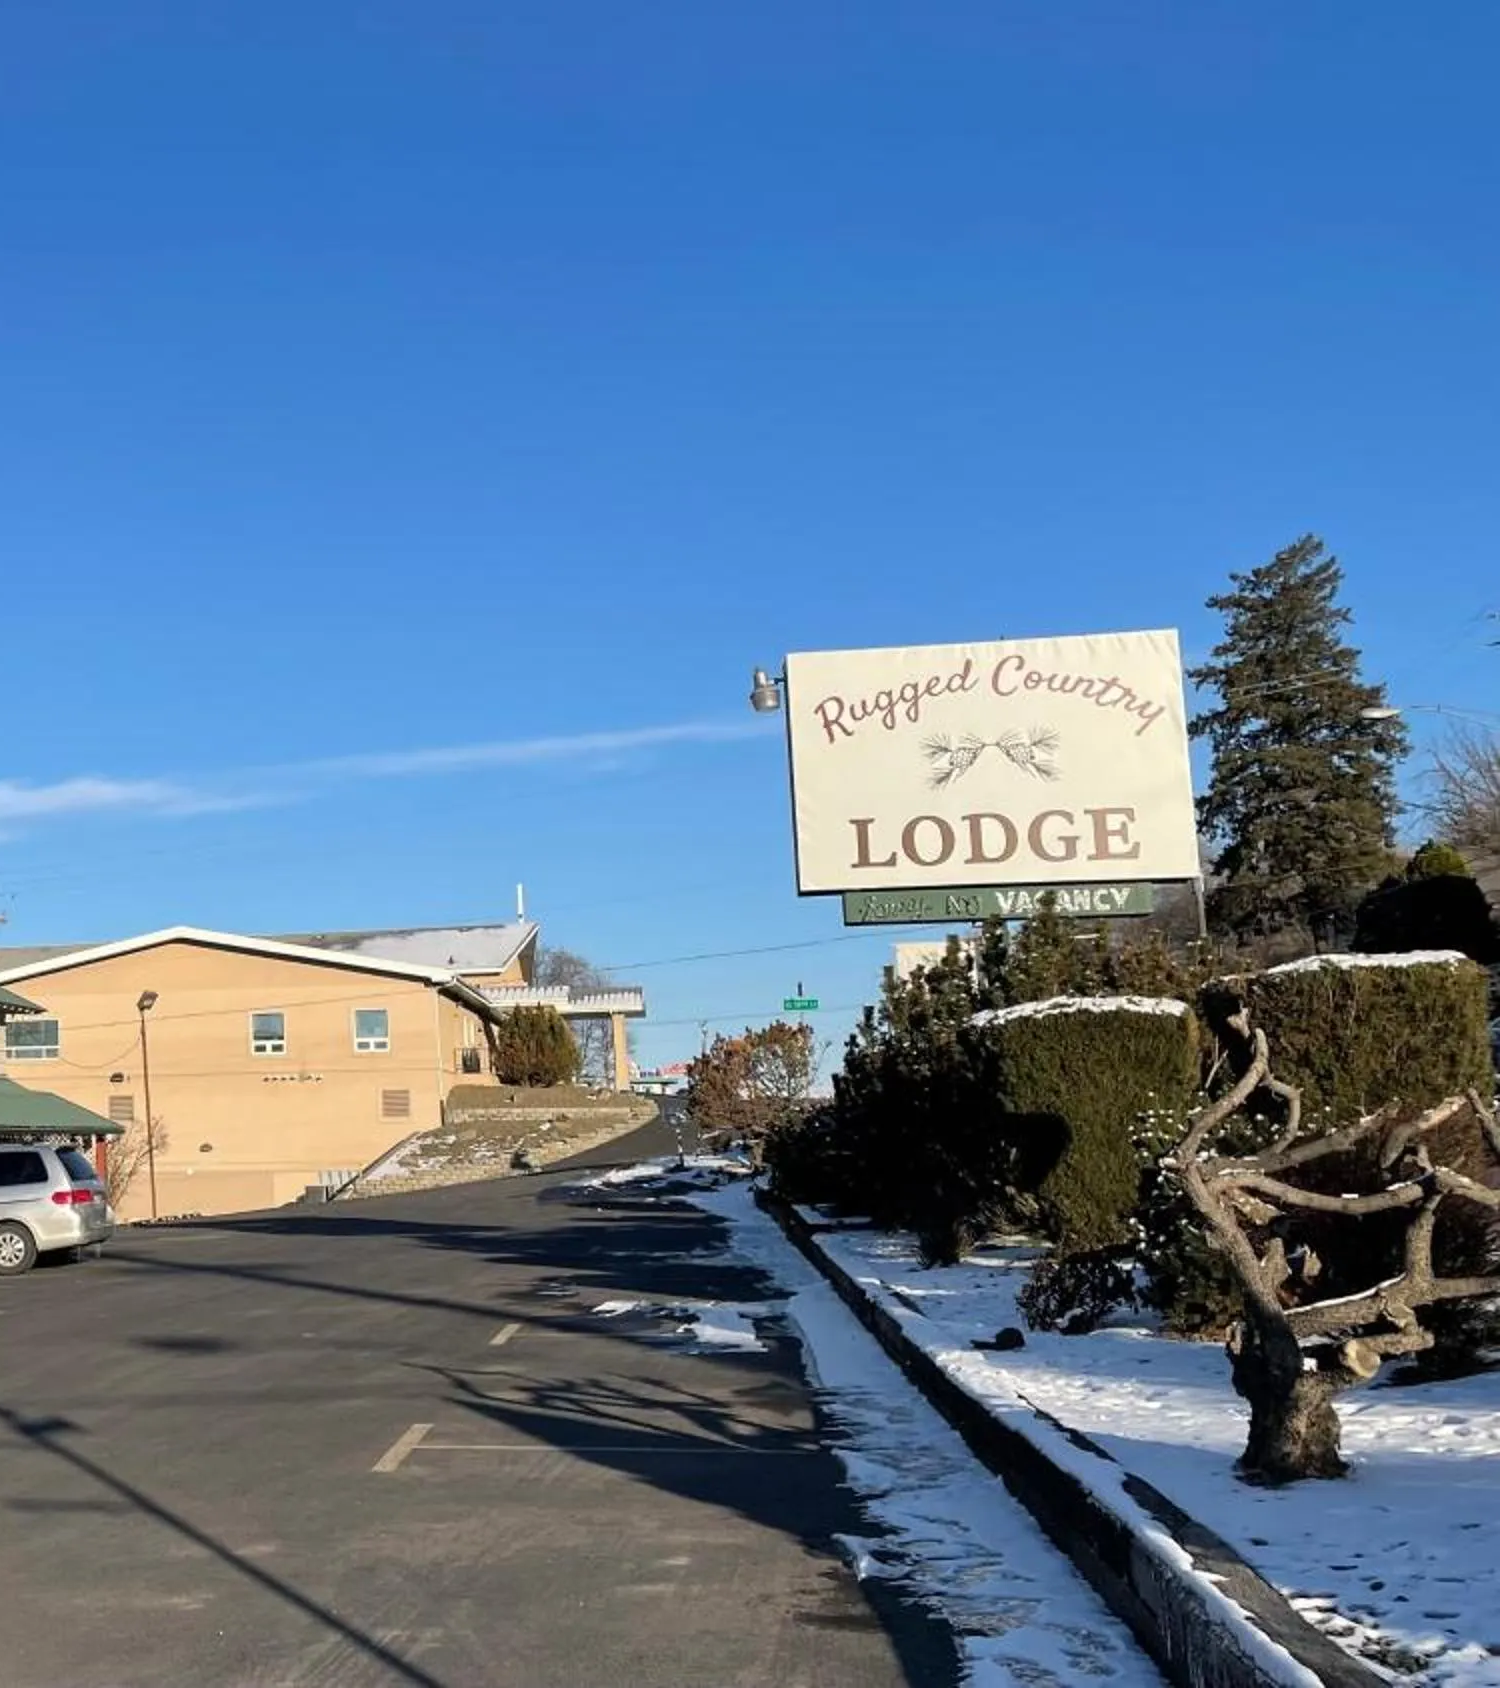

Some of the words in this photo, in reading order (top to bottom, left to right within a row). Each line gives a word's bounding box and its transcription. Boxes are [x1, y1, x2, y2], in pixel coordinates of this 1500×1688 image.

[813, 657, 979, 744] Rugged
[991, 655, 1166, 736] Country
[848, 807, 1141, 868] LODGE
